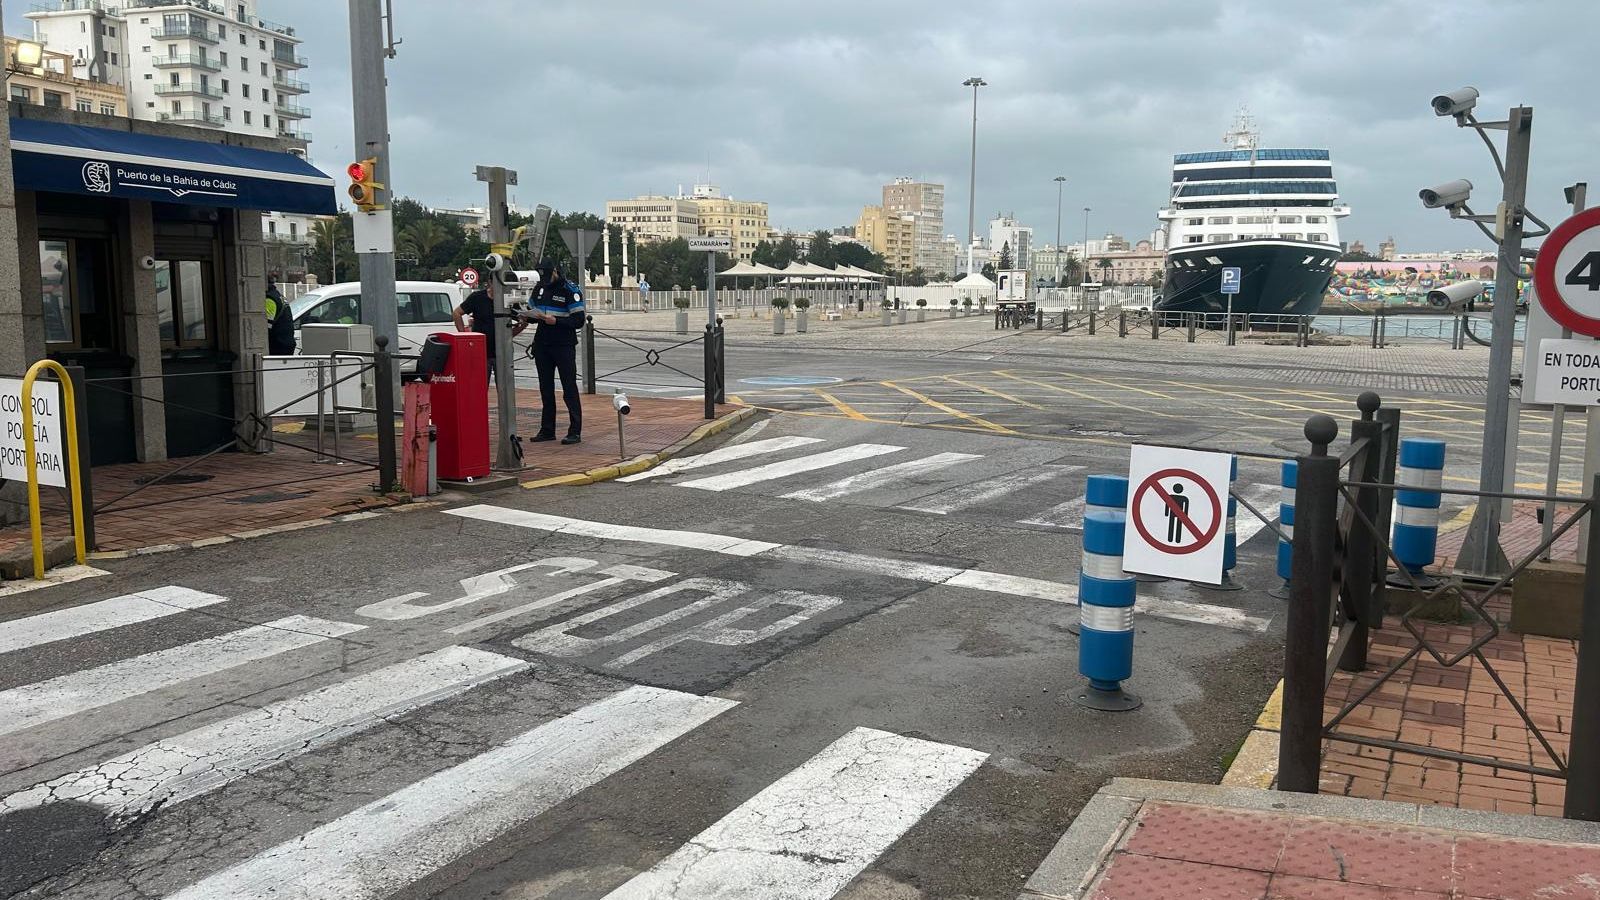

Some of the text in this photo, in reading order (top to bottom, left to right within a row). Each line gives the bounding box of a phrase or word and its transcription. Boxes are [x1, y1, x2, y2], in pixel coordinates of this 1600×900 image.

[117, 168, 237, 190] Puerto de la Bahía de Cádiz
[464, 273, 475, 281] 20
[1223, 270, 1235, 284] P
[1564, 251, 1600, 291] 4
[1544, 352, 1600, 369] EN TODA
[1, 394, 52, 417] CONROL
[0, 446, 62, 473] PORTARIA
[355, 556, 844, 669] STOP
